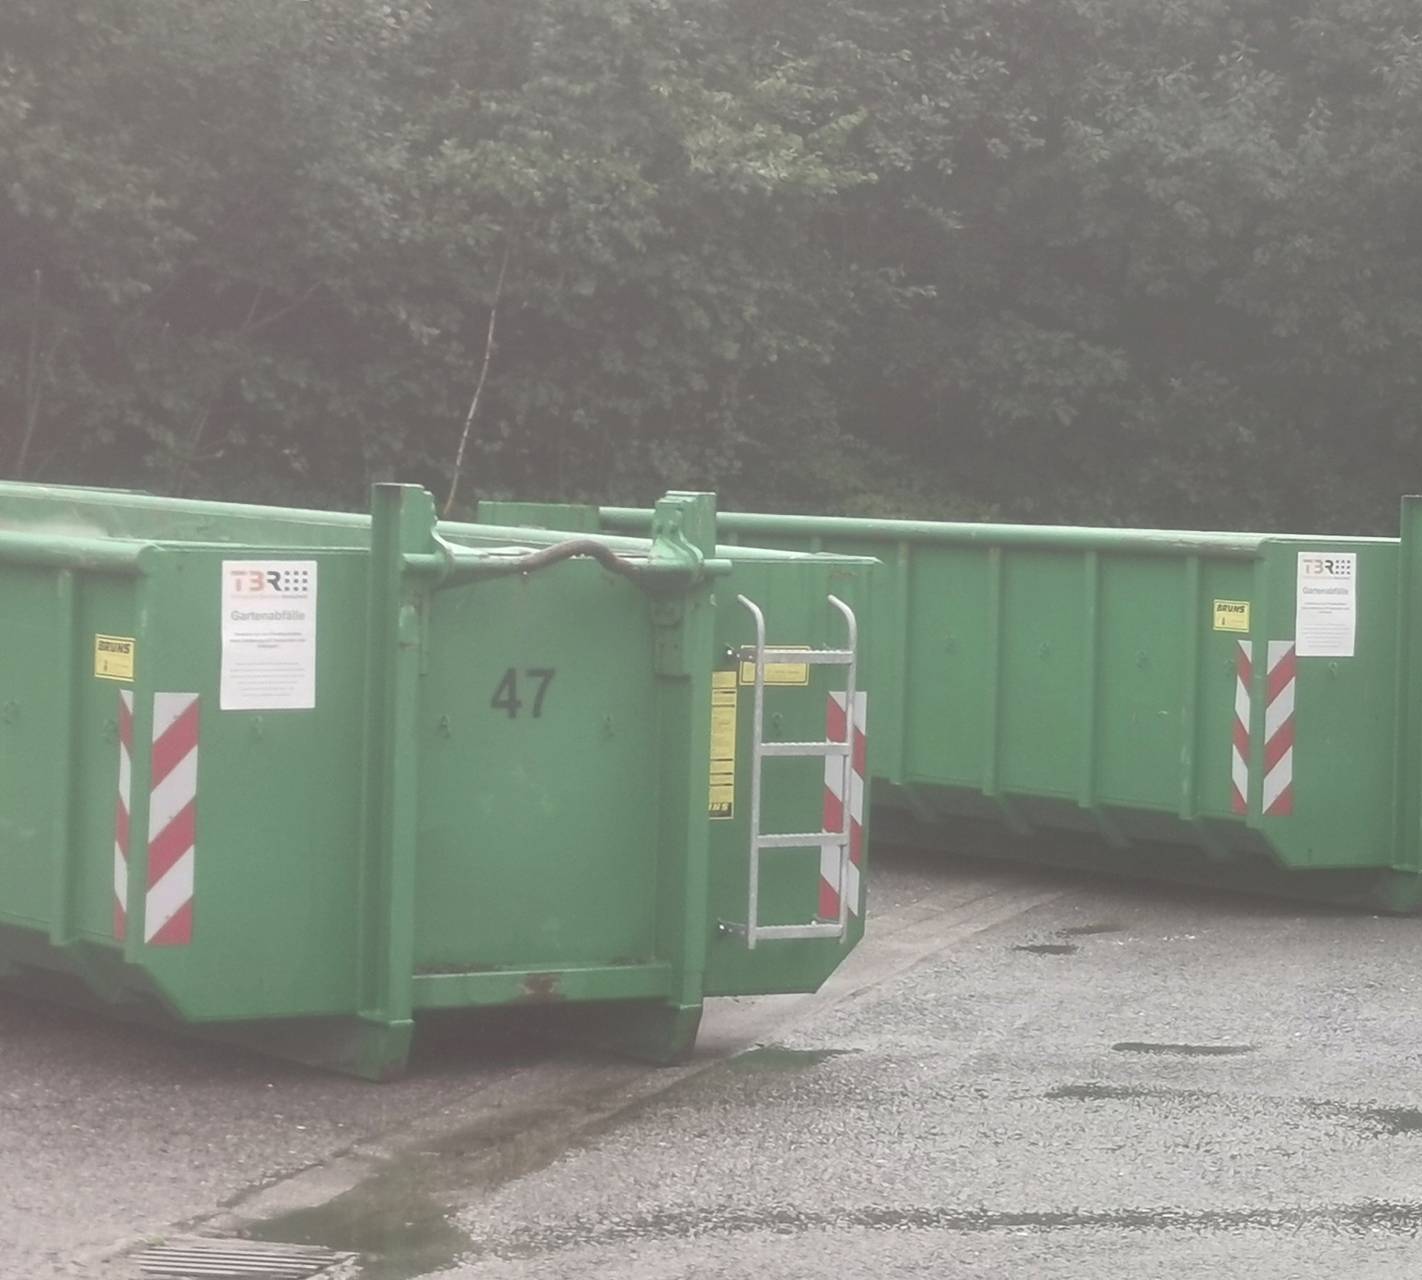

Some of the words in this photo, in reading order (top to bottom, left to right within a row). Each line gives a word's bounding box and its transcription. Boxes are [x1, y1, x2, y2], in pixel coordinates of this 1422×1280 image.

[230, 570, 282, 592] TBR
[230, 610, 306, 621] Gartenabfälle
[1217, 604, 1246, 613] BRUNS
[490, 668, 556, 719] 47
